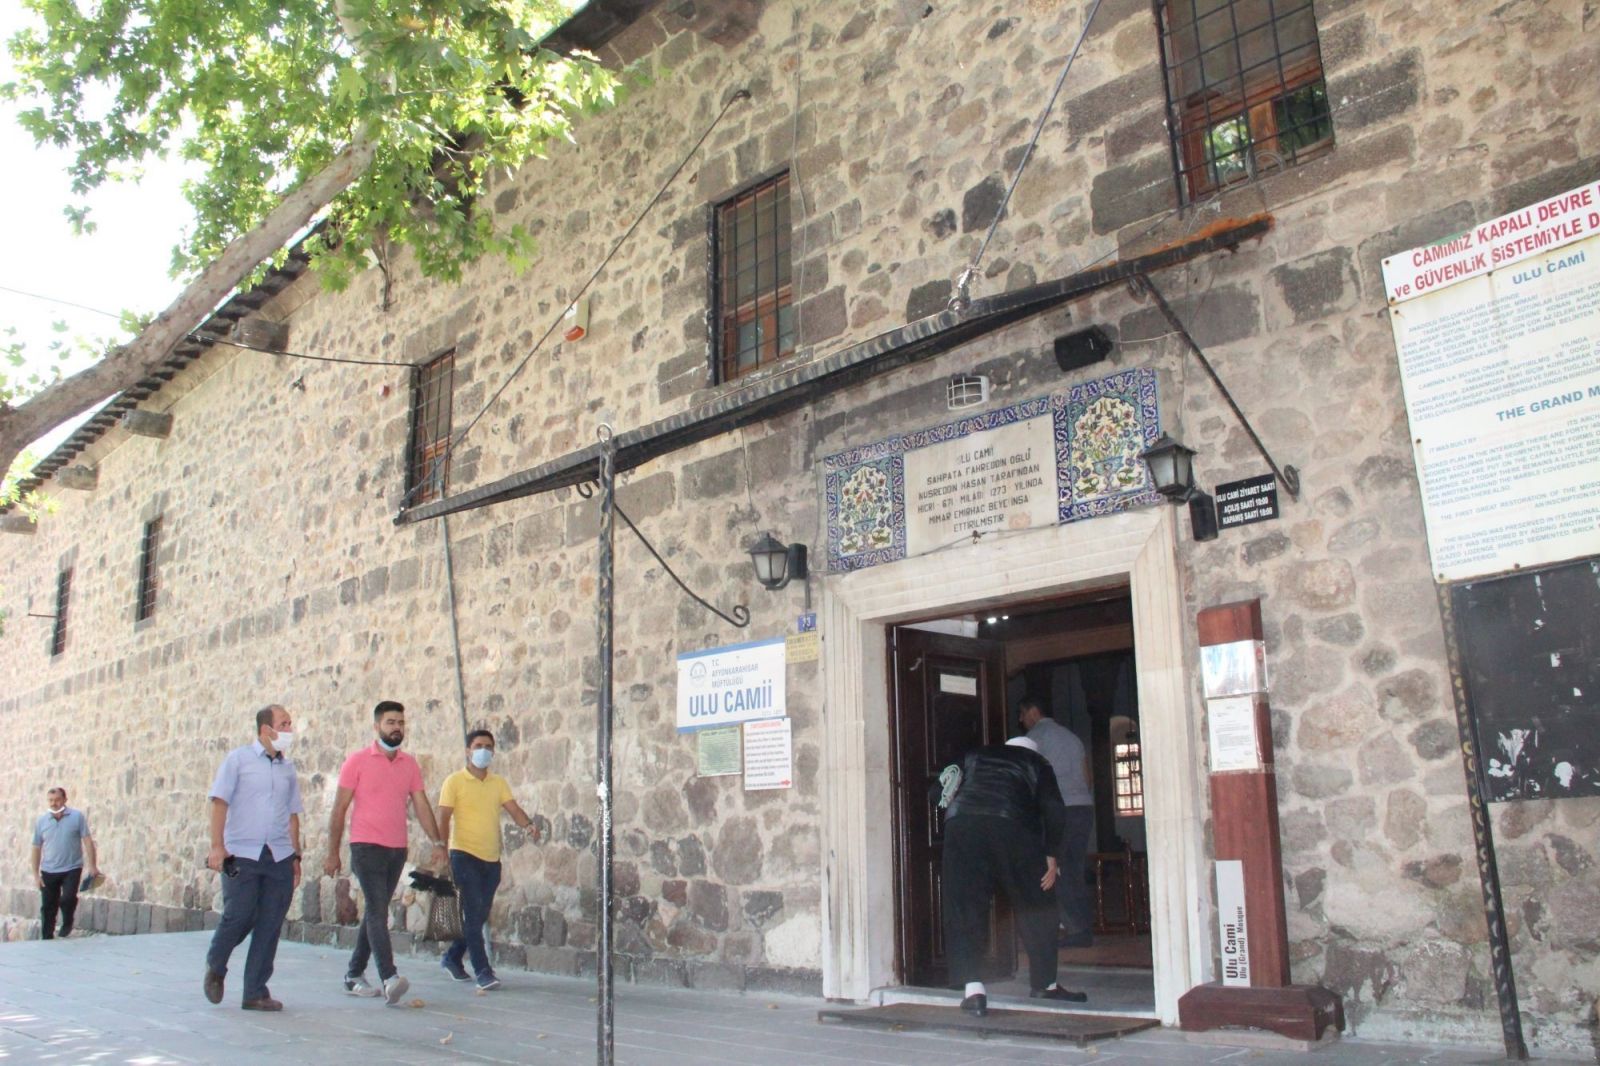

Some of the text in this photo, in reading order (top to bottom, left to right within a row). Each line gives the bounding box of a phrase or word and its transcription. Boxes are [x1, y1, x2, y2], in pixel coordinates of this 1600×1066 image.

[1478, 211, 1531, 245] KAPALI
[1538, 189, 1592, 222] DEVRE
[1512, 270, 1543, 285] ULU
[1546, 250, 1586, 273] CAMİ
[1395, 284, 1410, 298] ve
[1496, 406, 1526, 422] THE
[1530, 390, 1583, 413] GRAND
[1241, 498, 1255, 509] SAATİ
[1245, 508, 1259, 519] SAATİ
[689, 693, 718, 717] ULU
[1224, 923, 1239, 979] Ulu Cami
[1236, 906, 1247, 979] Ulu (Grand) Mosque
